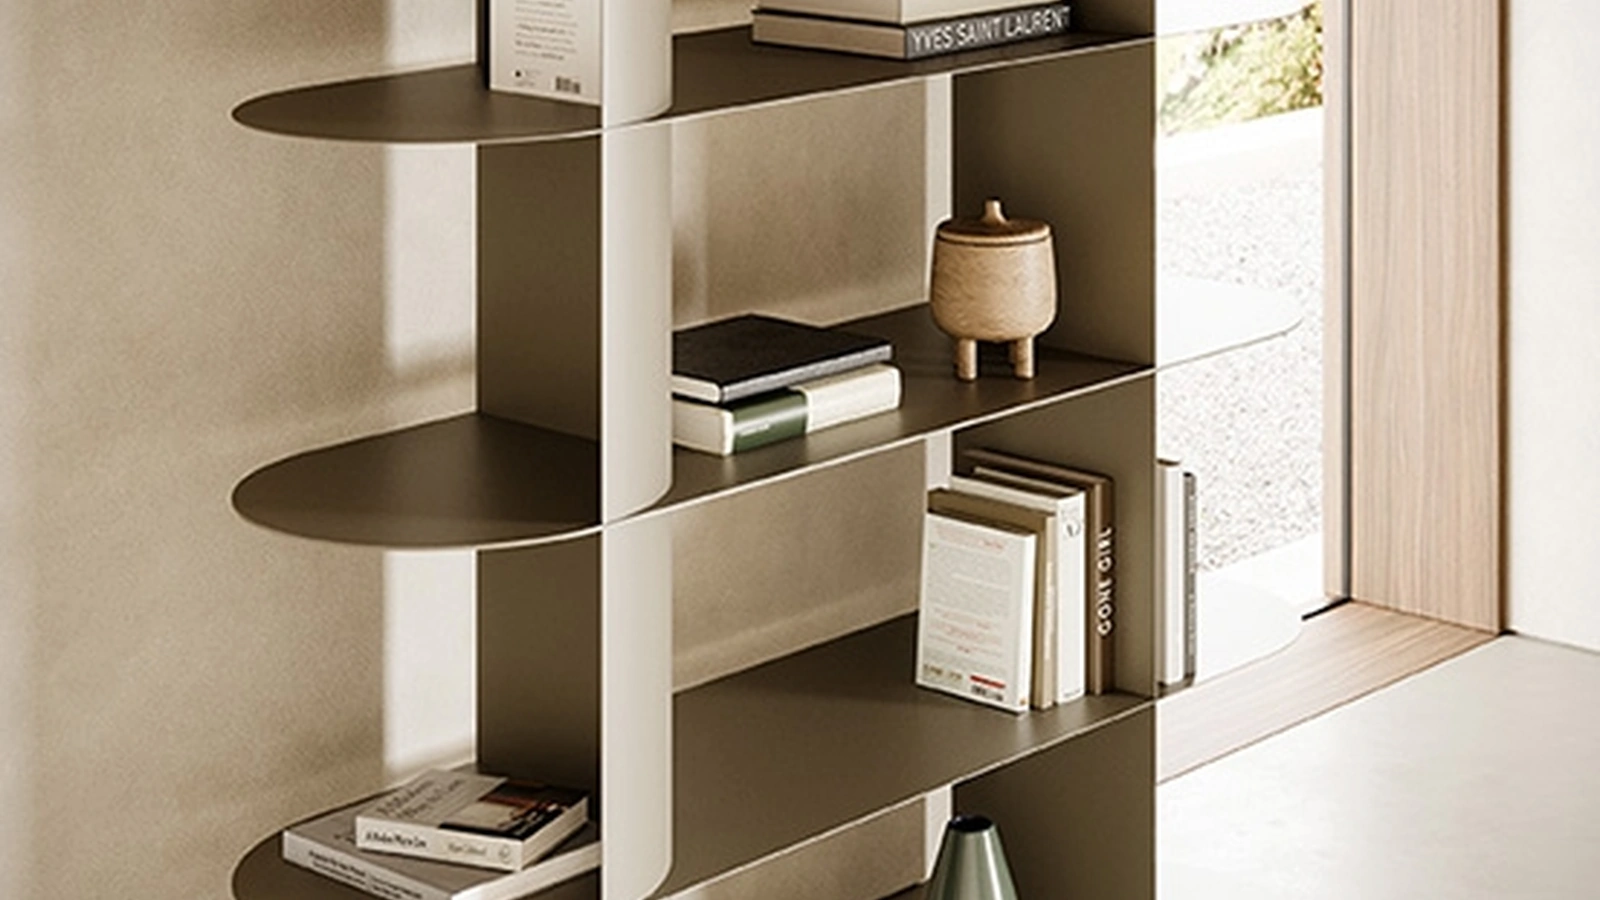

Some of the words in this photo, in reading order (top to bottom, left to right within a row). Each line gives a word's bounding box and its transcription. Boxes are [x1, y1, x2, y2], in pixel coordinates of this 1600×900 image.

[911, 25, 954, 52] YVES
[956, 16, 1003, 46] SAINT
[1004, 5, 1071, 38] LAURENT
[1096, 527, 1112, 573] GIRL
[1096, 577, 1112, 636] GONE
